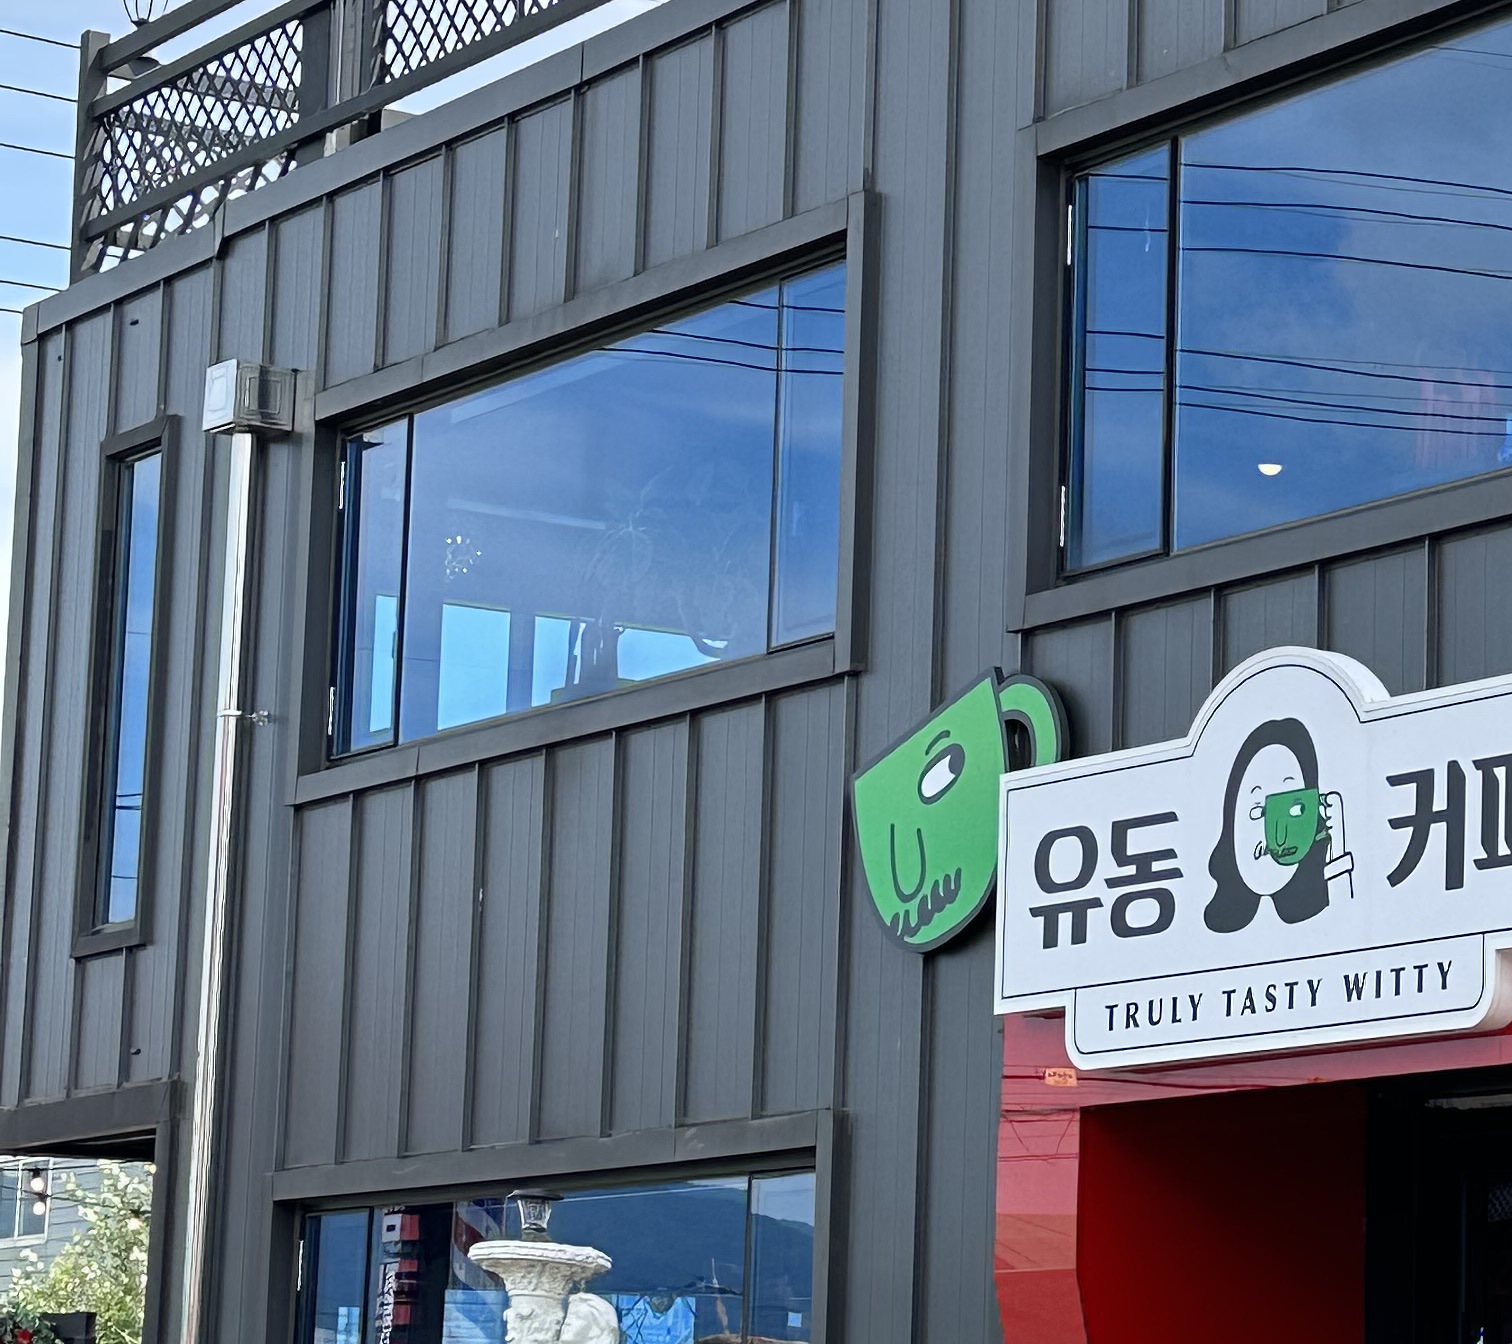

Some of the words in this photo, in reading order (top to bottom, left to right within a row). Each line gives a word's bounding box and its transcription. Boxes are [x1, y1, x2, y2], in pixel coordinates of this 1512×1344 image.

[1029, 811, 1184, 950] 유동
[1104, 993, 1203, 1032] TRULY
[1222, 978, 1323, 1017] TASTY
[1343, 960, 1454, 1003] WITTY
